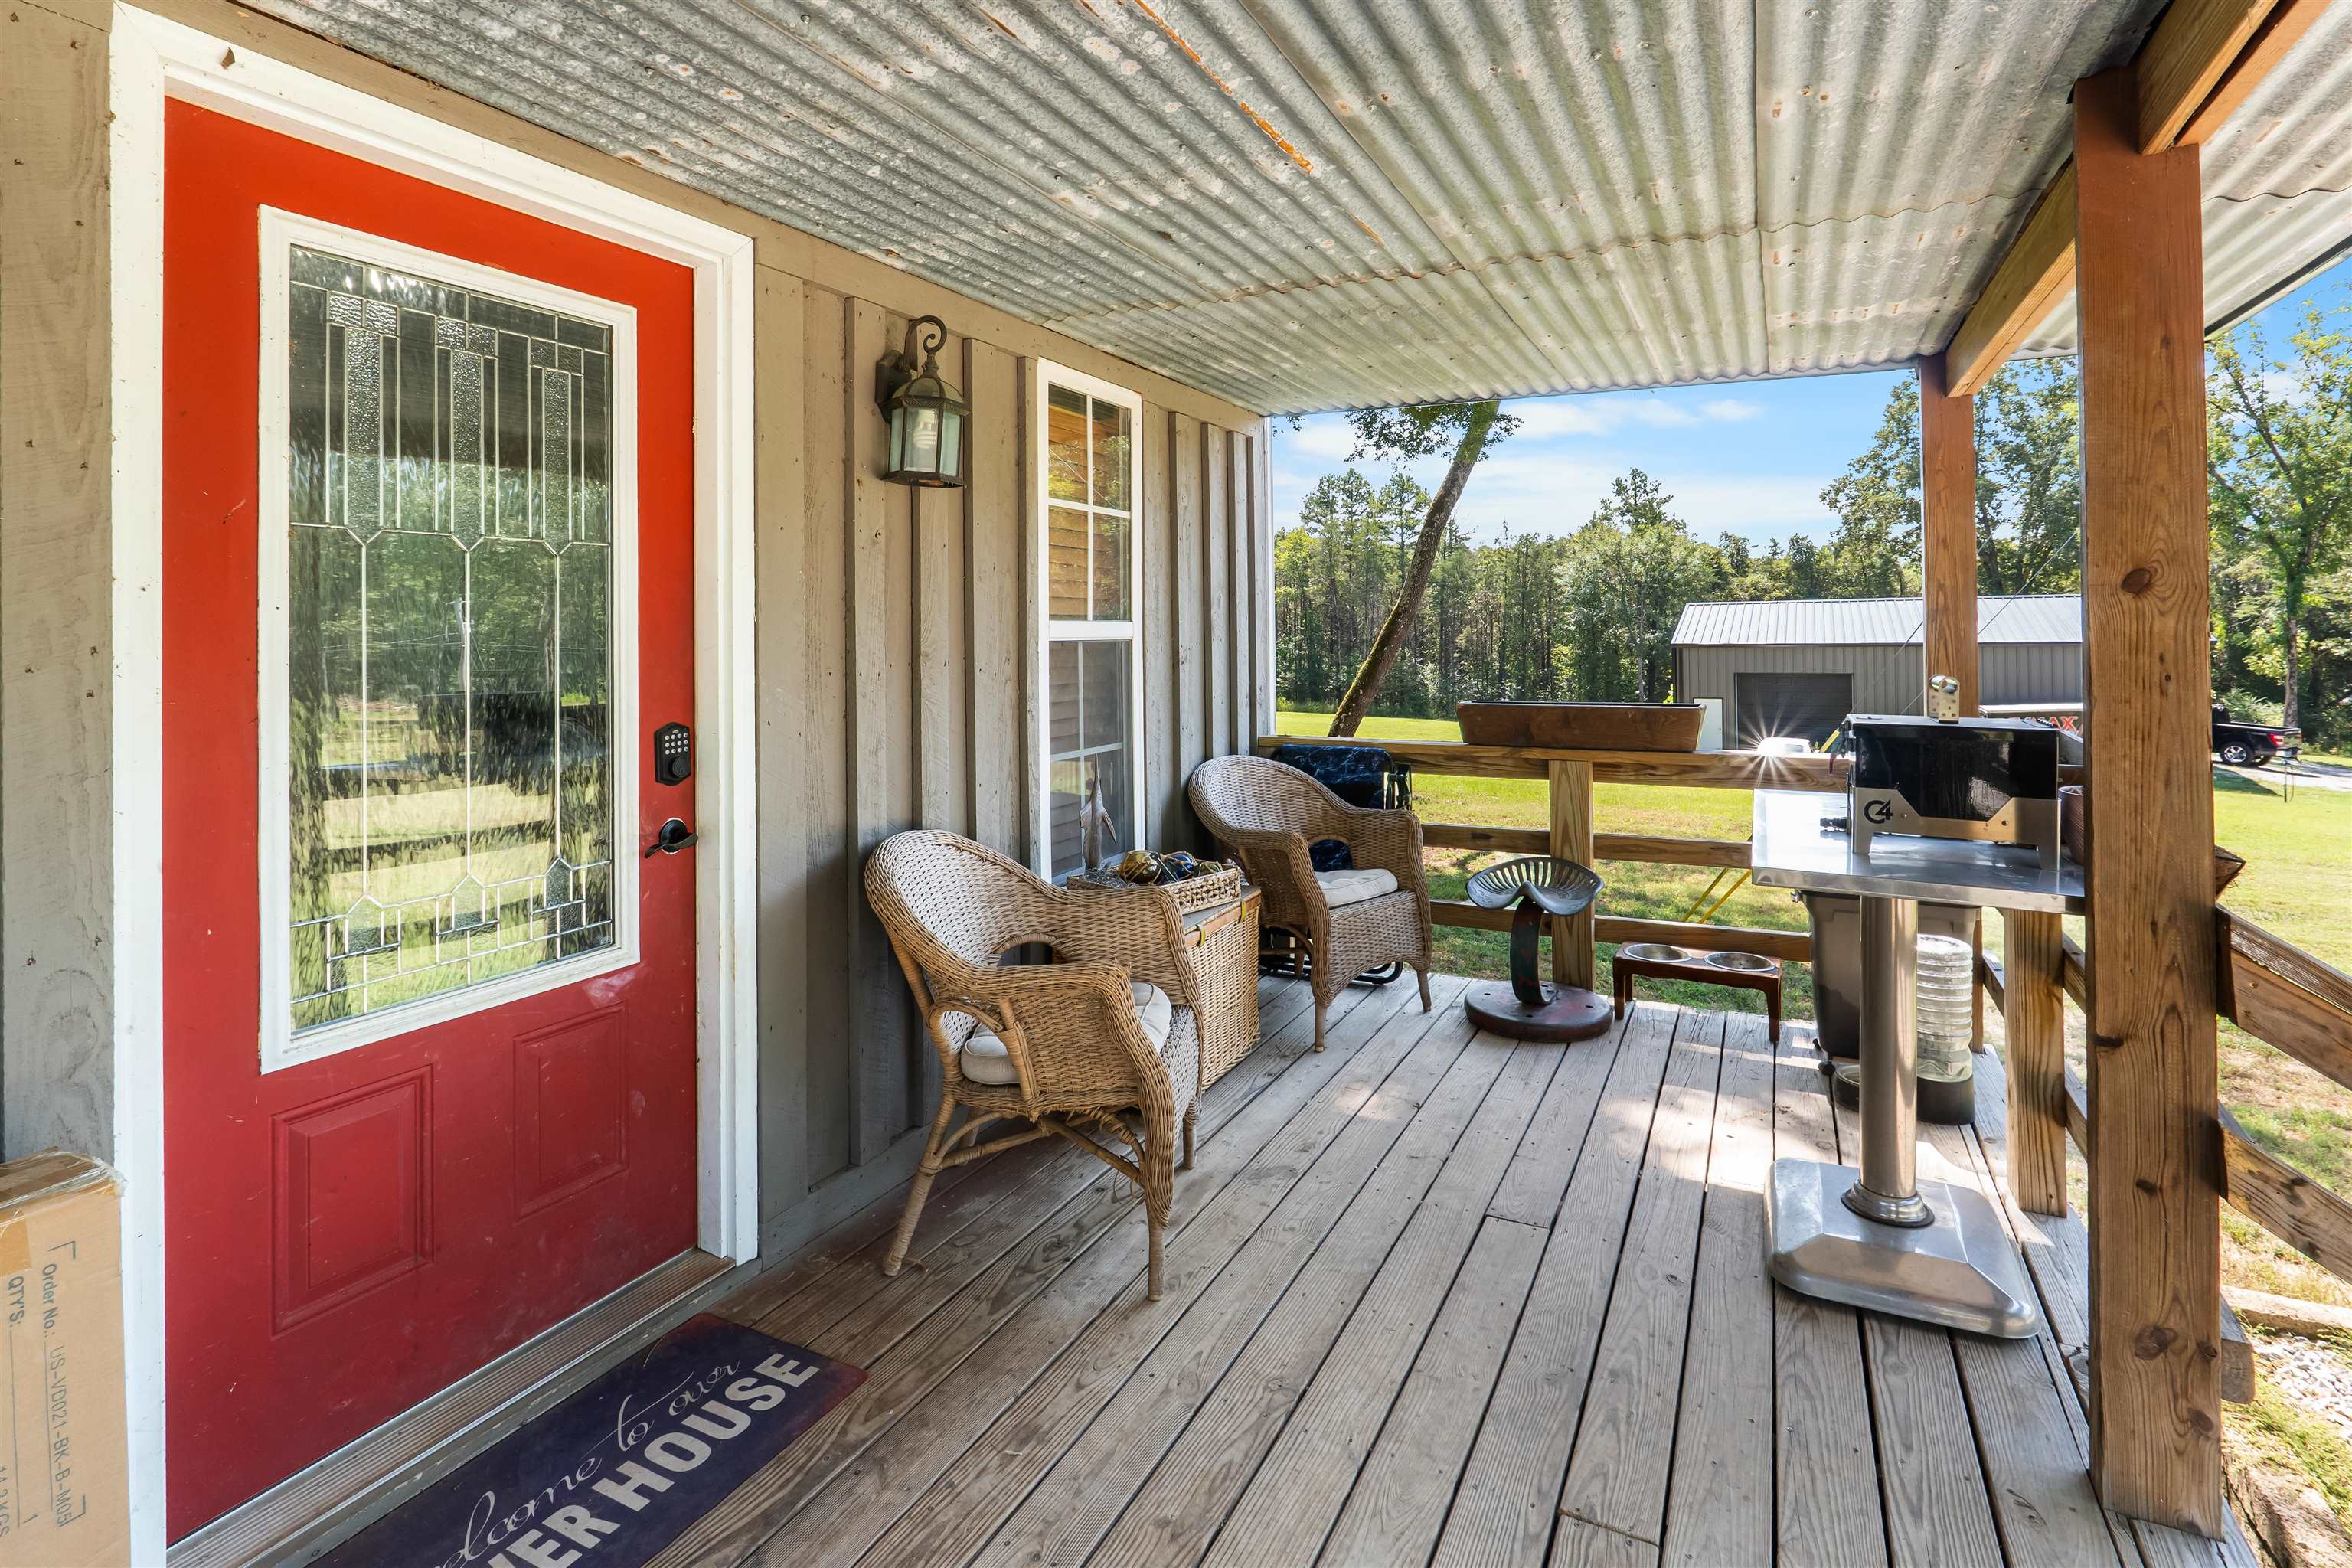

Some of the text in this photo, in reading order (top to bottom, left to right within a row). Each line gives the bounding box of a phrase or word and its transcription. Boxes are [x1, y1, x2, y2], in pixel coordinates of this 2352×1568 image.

[42, 1263, 57, 1305] Order
[8, 1276, 38, 1524] QTY'S: 1
[434, 1360, 740, 1568] elcome to our
[590, 1353, 820, 1512] HOUSE
